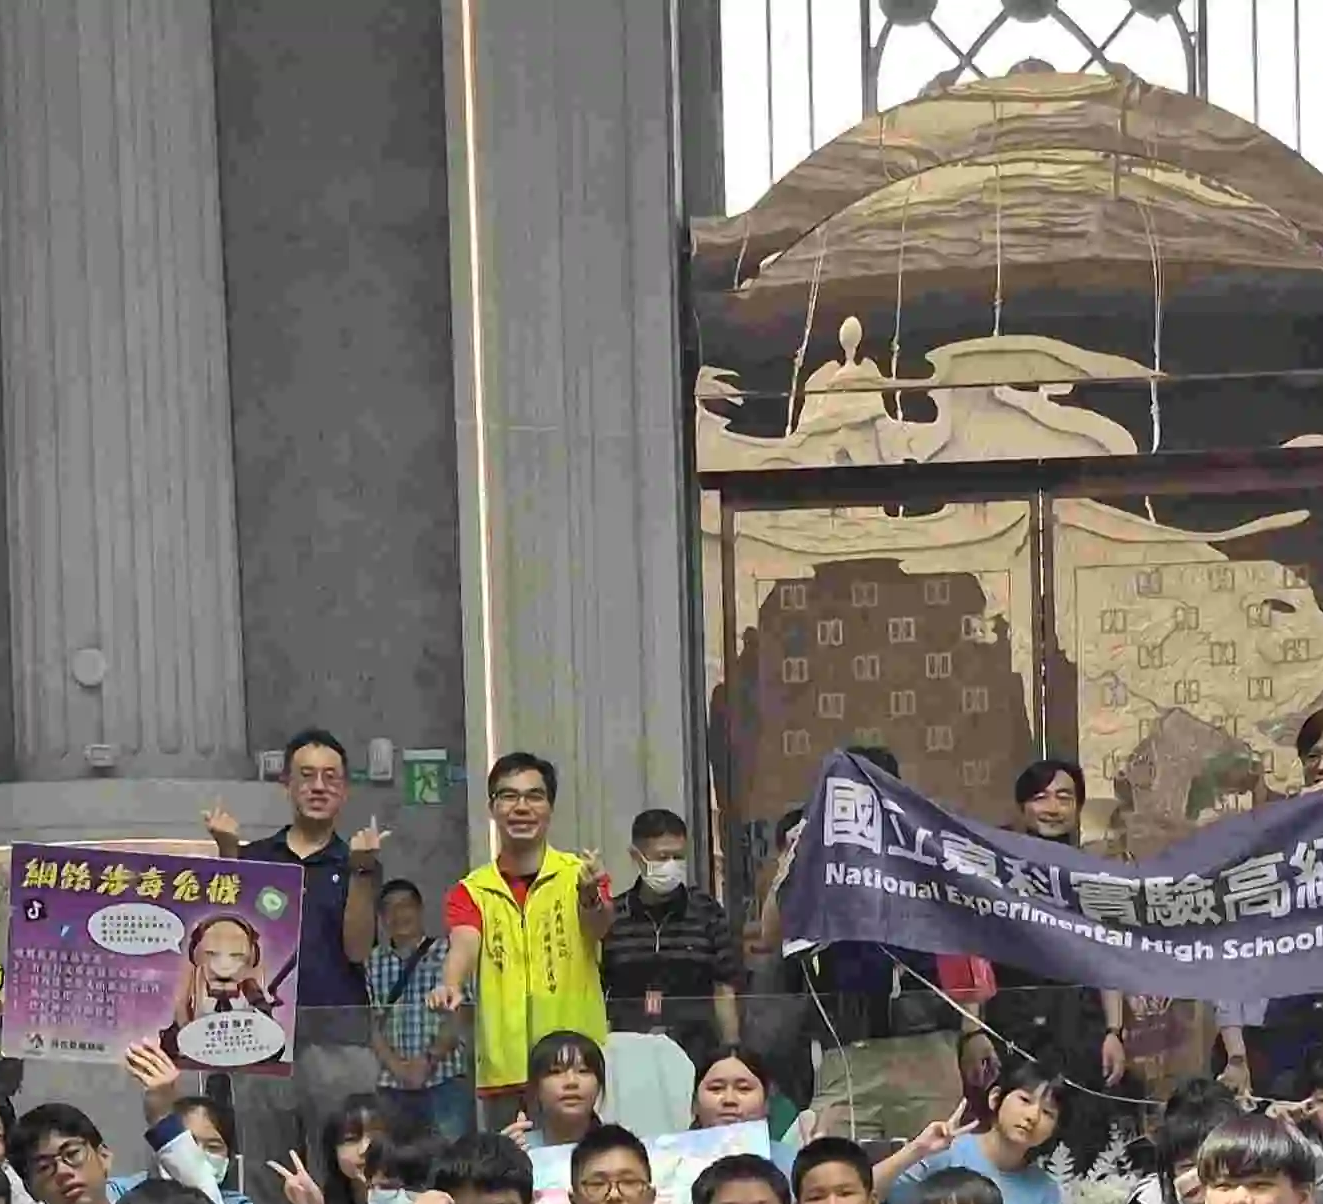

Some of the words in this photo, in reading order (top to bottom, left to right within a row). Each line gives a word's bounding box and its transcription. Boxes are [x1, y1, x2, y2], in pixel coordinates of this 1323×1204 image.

[825, 862, 940, 899] National
[1141, 936, 1213, 962] High
[1223, 925, 1323, 960] School
